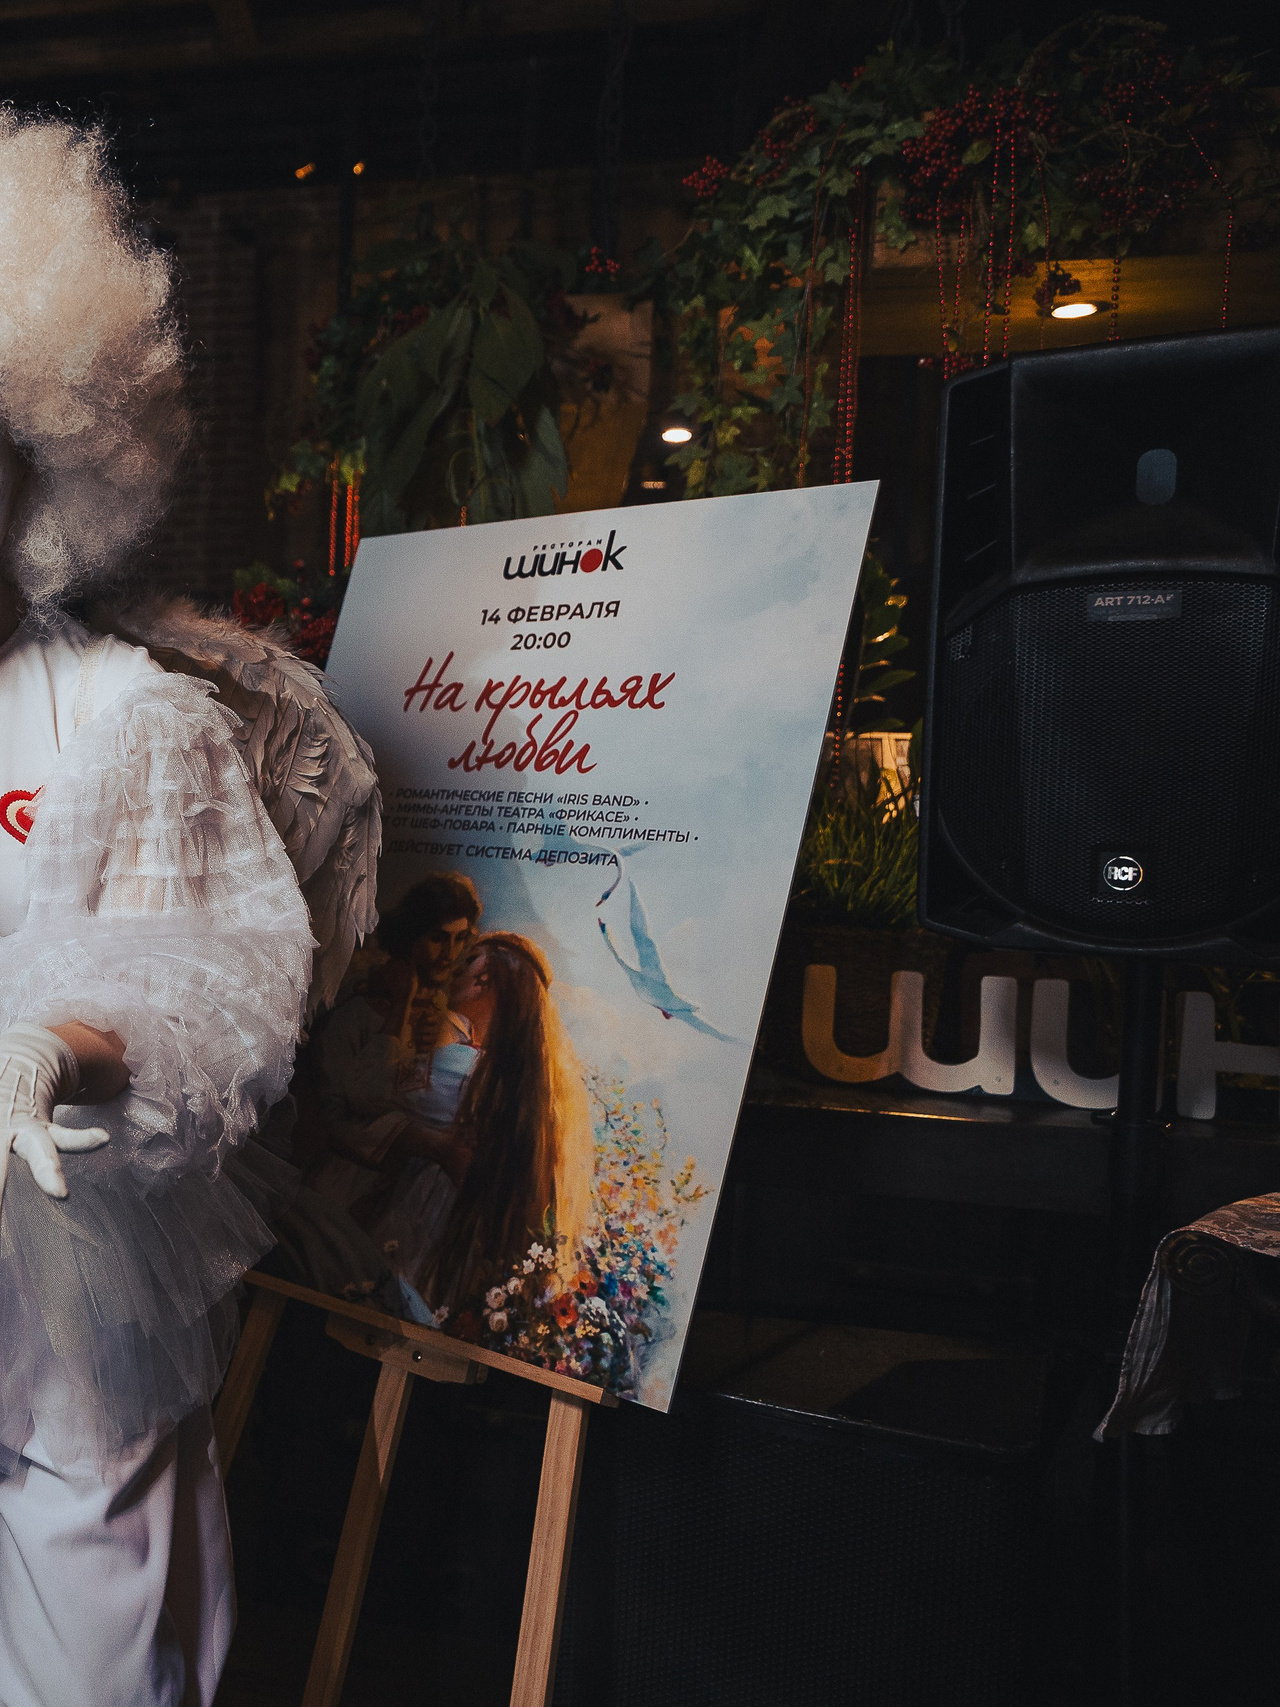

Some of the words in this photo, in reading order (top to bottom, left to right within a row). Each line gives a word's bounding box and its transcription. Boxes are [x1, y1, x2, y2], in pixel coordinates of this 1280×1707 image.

[533, 539, 603, 551] РЕСТОРАН
[1094, 596, 1124, 607] ART
[481, 608, 501, 625] 14
[507, 600, 621, 624] ФЕВРАЛЯ
[510, 631, 571, 650] 20:00
[403, 651, 468, 712] На
[474, 672, 676, 745] крыльях
[448, 710, 598, 775] любви
[395, 788, 503, 803] РОМАНТИЧЕСКИЕ
[507, 791, 553, 804] ПЕСНИ
[396, 803, 493, 817] МИМЫ-АНГЕЛЫ
[497, 806, 545, 819] ТЕАТРА
[548, 808, 630, 823] «ФРИКАСЕ»
[410, 817, 495, 832] ШЕФ-ПОВАРА
[506, 822, 566, 836] ПАРНЫЕ
[569, 825, 690, 843] КОМПЛИМЕНТЫ
[388, 838, 464, 856] ДЕЙСТВУЕТ
[466, 844, 532, 861] СИСТЕМА
[535, 849, 619, 867] ДЕПОЗИТА
[1107, 866, 1139, 881] RCF
